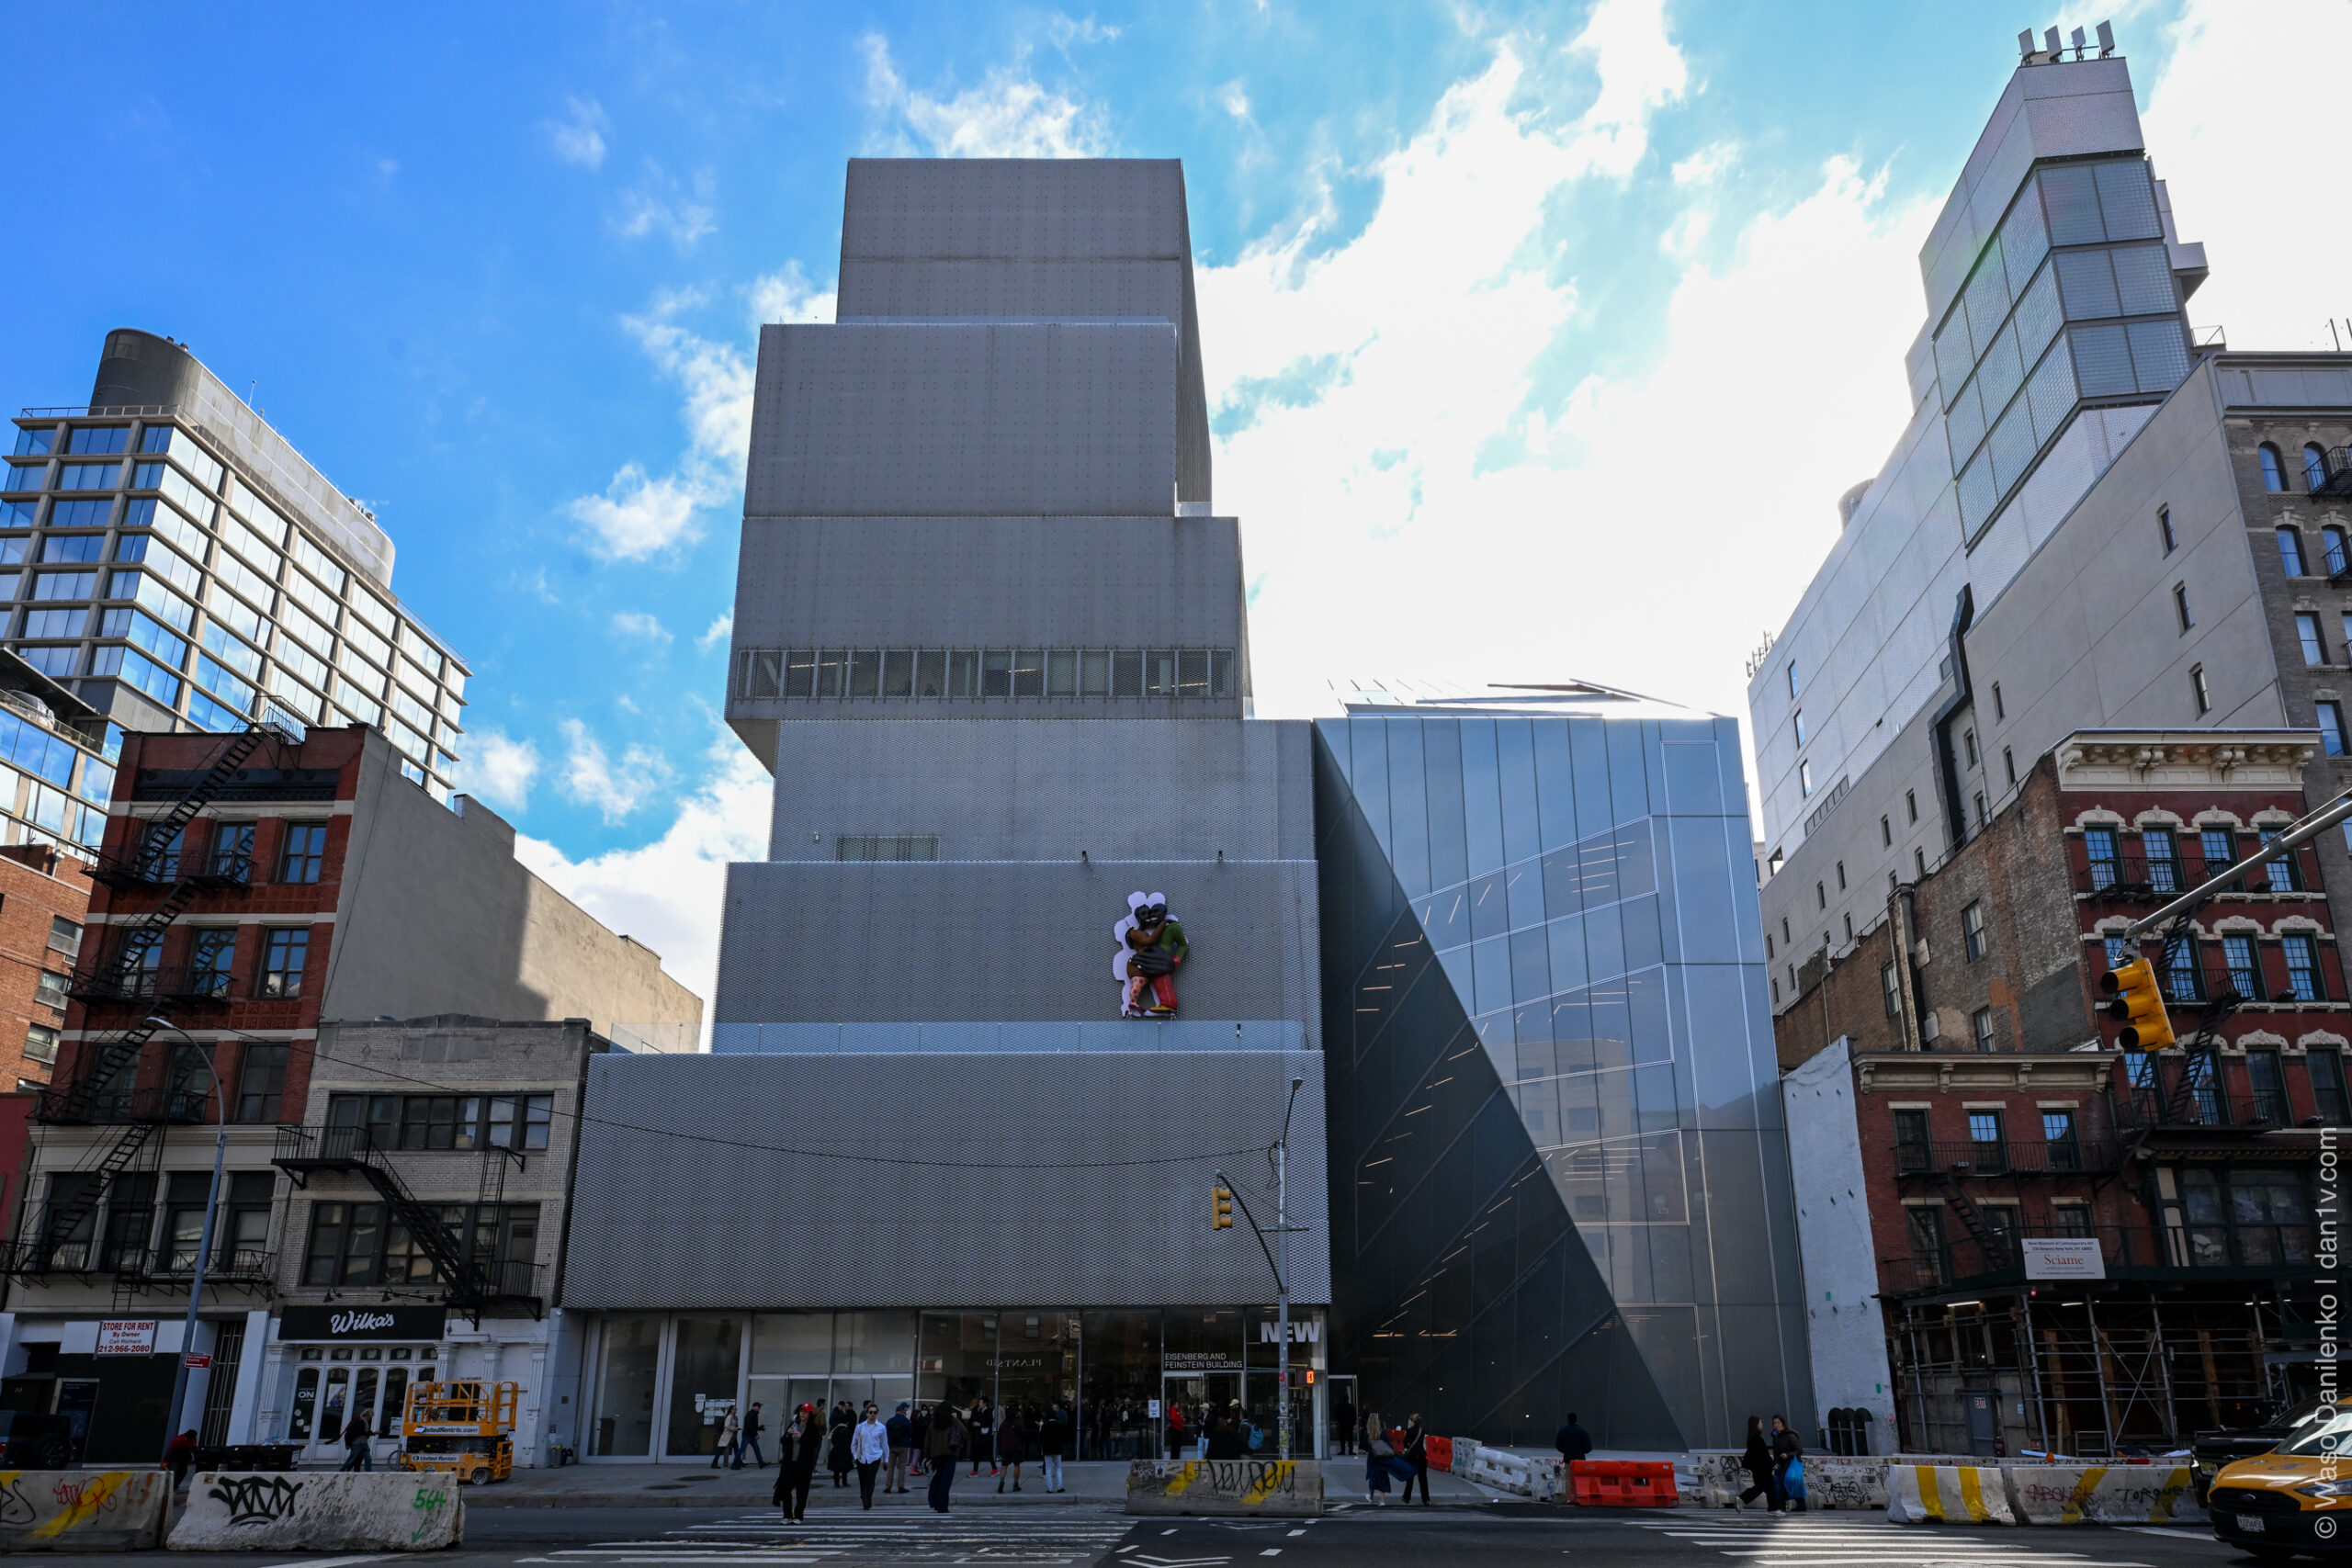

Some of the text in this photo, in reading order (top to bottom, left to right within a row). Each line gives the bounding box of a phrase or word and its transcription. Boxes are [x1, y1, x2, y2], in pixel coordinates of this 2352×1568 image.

[193, 372, 383, 569] PUBLIC
[2043, 1254, 2084, 1265] Sciame
[103, 1322, 154, 1331] STORE FOR RENT
[330, 1310, 395, 1334] Wilka's
[1261, 1322, 1321, 1343] NEW
[98, 1345, 150, 1353] 212-966-2080
[1164, 1352, 1227, 1360] EISENBERG AND
[1164, 1360, 1243, 1369] FEINSTEIN BUILDING
